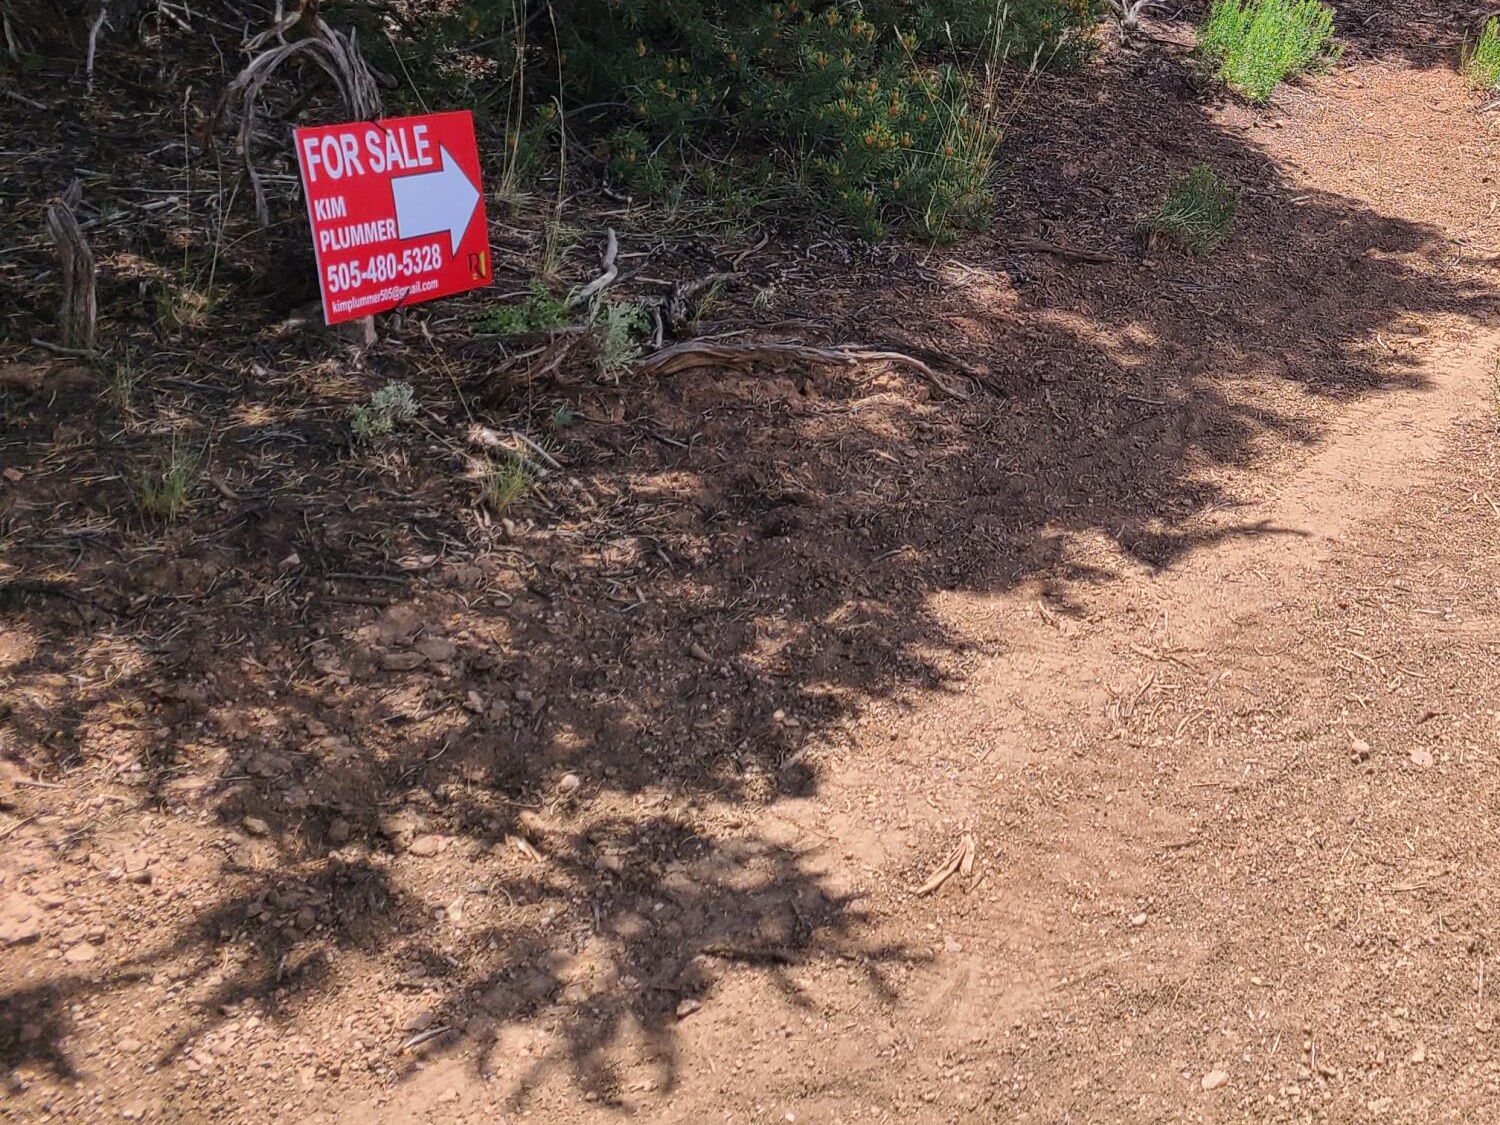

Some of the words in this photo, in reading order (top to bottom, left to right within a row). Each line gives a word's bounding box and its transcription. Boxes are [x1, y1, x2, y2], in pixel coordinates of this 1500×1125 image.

[304, 135, 364, 182] FOR
[365, 125, 432, 173] SALE
[314, 196, 346, 221] KIM
[320, 219, 396, 252] PLUMMER
[327, 244, 442, 292] 505-480-5328
